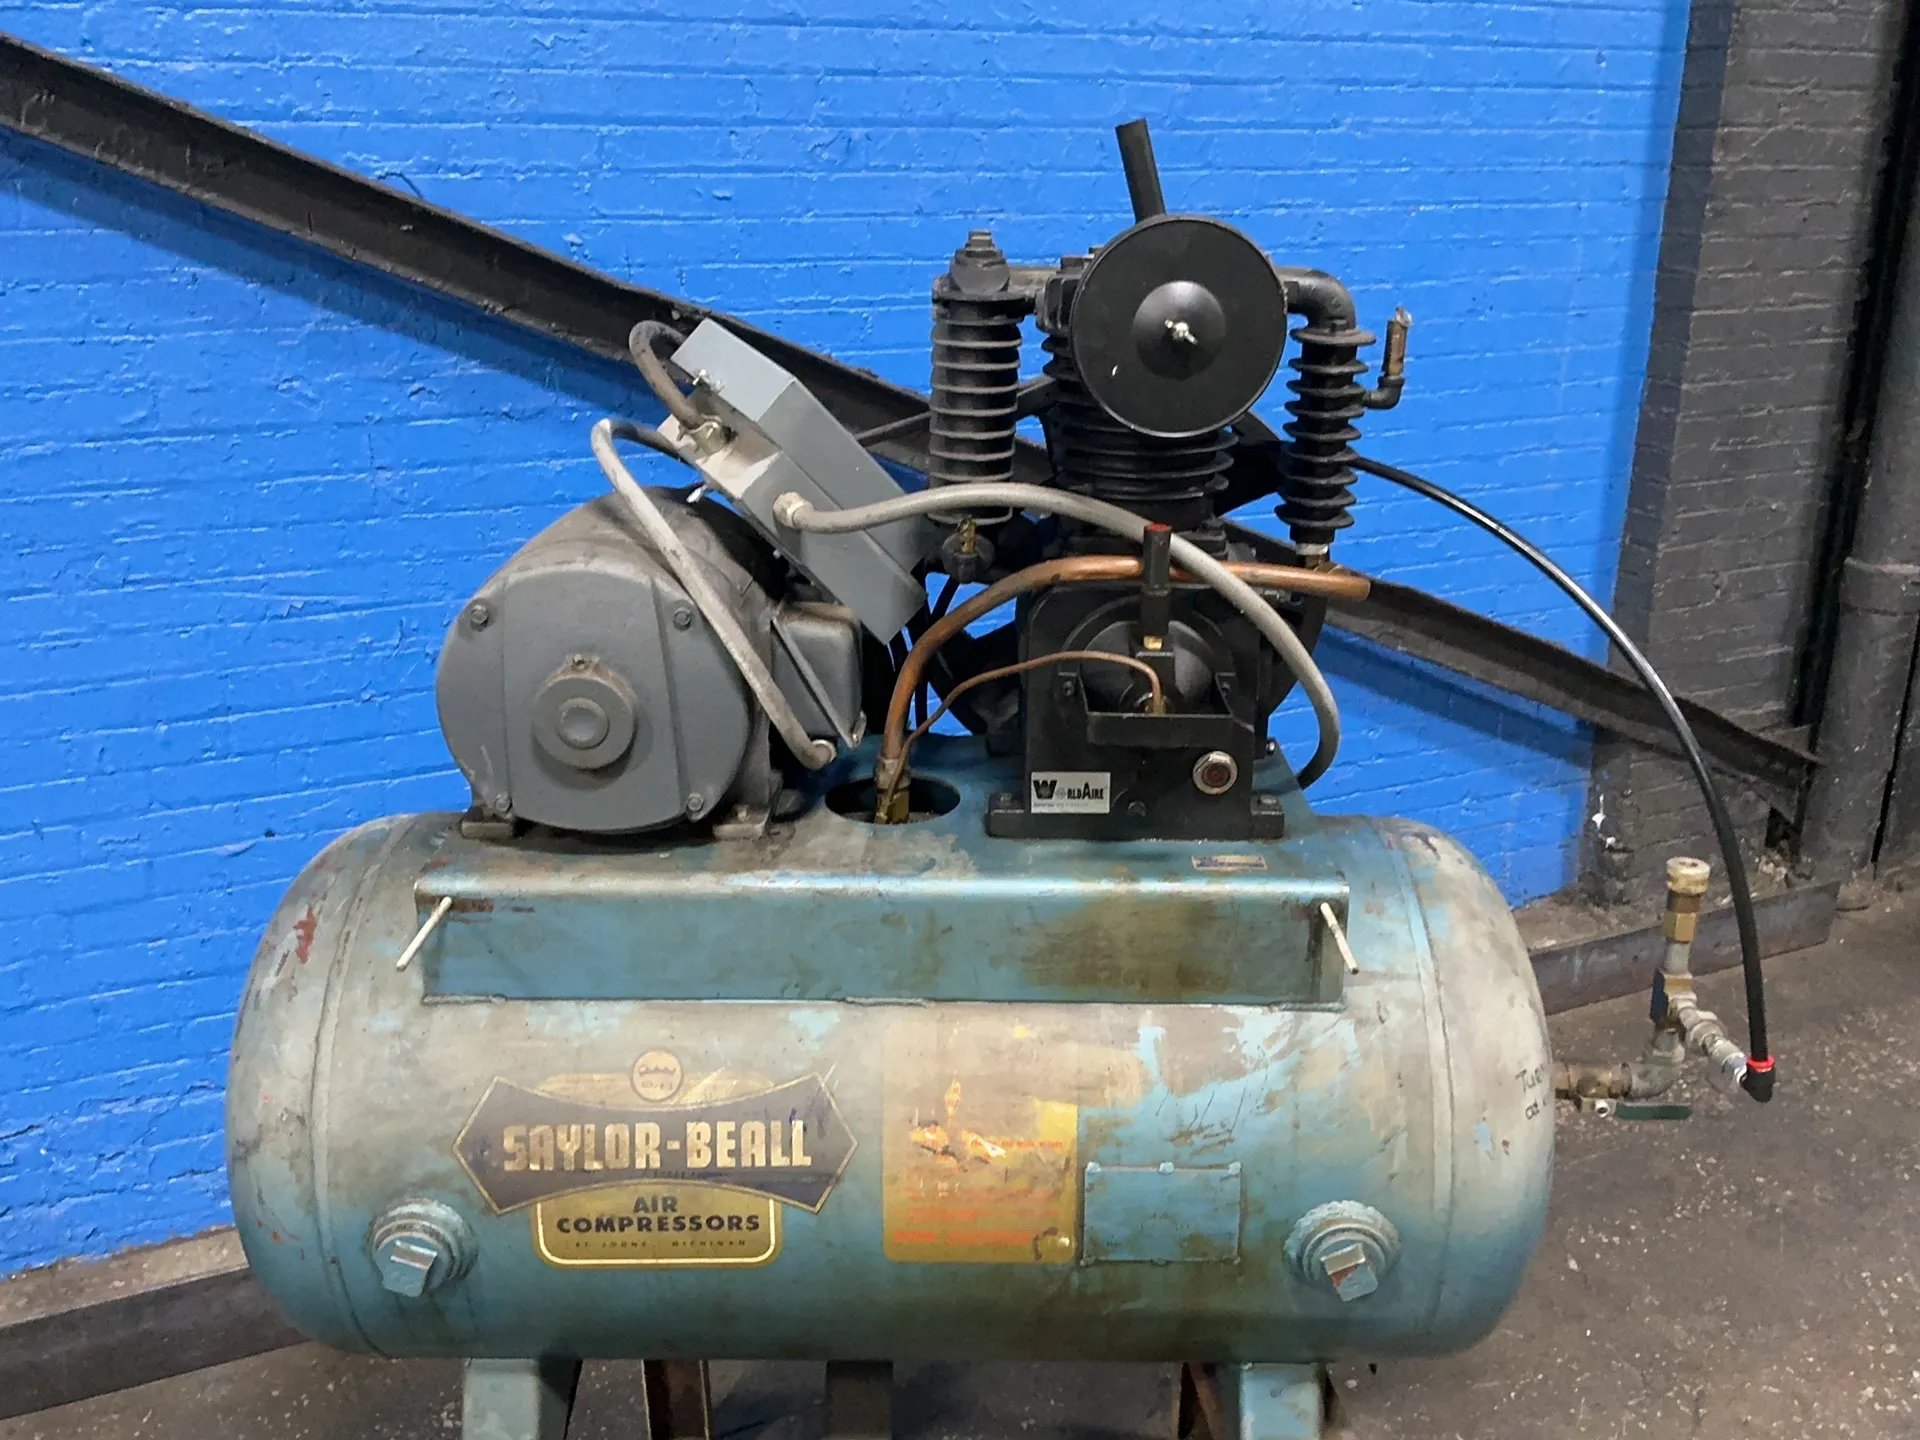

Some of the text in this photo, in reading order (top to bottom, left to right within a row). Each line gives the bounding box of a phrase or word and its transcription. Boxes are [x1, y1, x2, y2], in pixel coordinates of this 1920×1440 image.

[503, 1119, 812, 1172] SAYLOR-BEALL
[633, 1195, 679, 1213] AIR
[557, 1214, 760, 1234] COMPRESSORS
